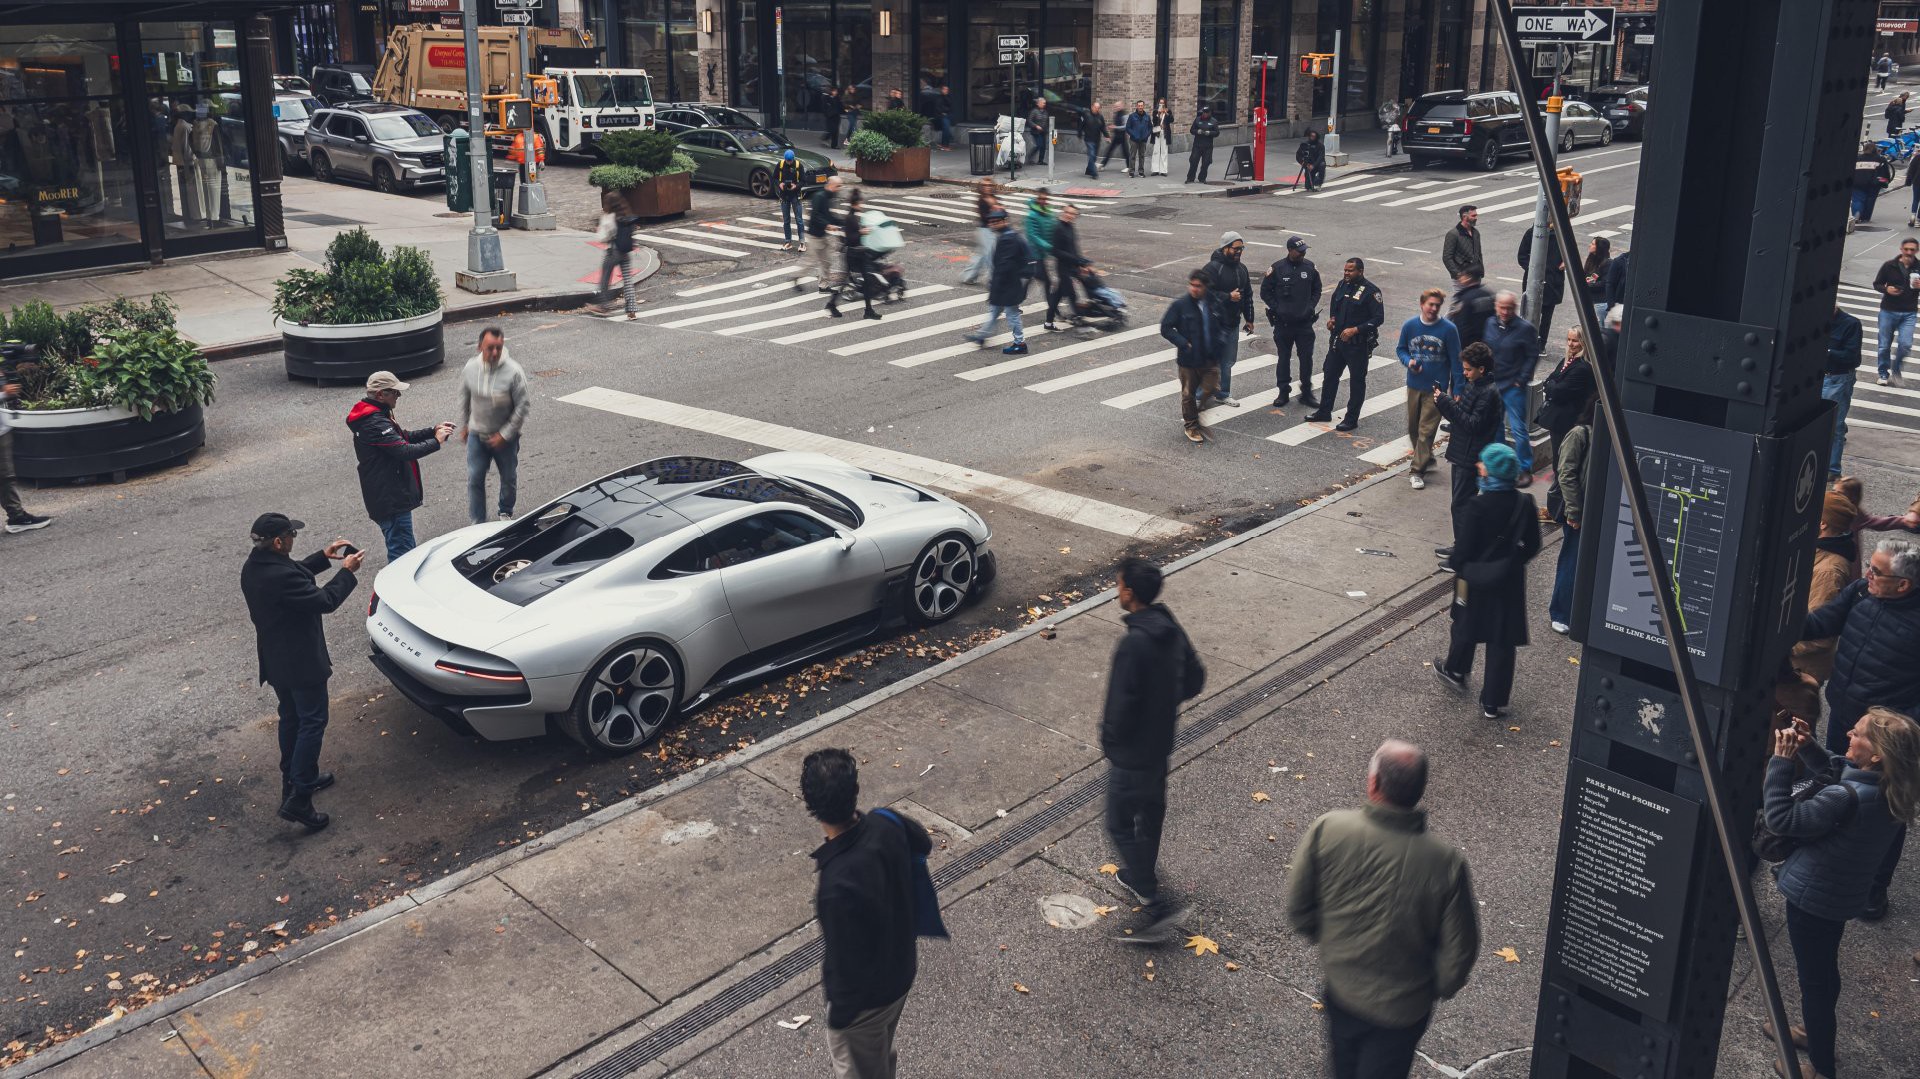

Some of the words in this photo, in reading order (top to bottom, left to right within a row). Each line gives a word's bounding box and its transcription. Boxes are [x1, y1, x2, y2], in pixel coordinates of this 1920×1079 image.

[410, 0, 448, 8] Washington
[1525, 18, 1554, 30] ONE
[1568, 18, 1598, 31] WAY
[1540, 52, 1553, 66] ONE
[378, 622, 421, 658] PORSCHE
[1604, 622, 1625, 633] HIGH
[1626, 627, 1645, 639] LINE
[1646, 634, 1668, 646] ACCE
[1687, 647, 1706, 657] INTS
[1584, 796, 1606, 808] Bicycles
[1586, 788, 1609, 802] Smoking
[1586, 777, 1606, 789] PARK
[1607, 786, 1630, 799] RULES
[1632, 795, 1670, 814] PROHIBIT
[1588, 823, 1621, 839] recreational
[1622, 837, 1645, 849] scooters
[1599, 812, 1618, 822] except
[1628, 824, 1648, 834] service
[1649, 831, 1663, 840] dogs
[1580, 827, 1602, 841] Walking
[1609, 840, 1632, 853] planting
[1632, 848, 1646, 858] beds
[1594, 841, 1618, 853] exposed
[1628, 855, 1646, 865] tracks
[1577, 850, 1594, 862] Sitting
[1604, 862, 1623, 873] railings
[1632, 873, 1656, 888] climbing
[1578, 842, 1597, 854] Picking
[1598, 850, 1617, 862] flowers
[1626, 863, 1644, 873] plants
[1573, 879, 1595, 893] Littering
[1574, 872, 1602, 887] authorized
[1603, 885, 1618, 894] areas
[1575, 864, 1597, 878] Drinking
[1620, 885, 1639, 895] except
[1625, 877, 1639, 886] High
[1639, 883, 1652, 892] Line
[1572, 887, 1596, 902] Throwing
[1597, 899, 1617, 910] objects
[1569, 910, 1598, 926] Solicitation
[1569, 903, 1601, 921] Obstructing
[1602, 918, 1628, 932] entrances
[1637, 934, 1653, 943] paths
[1570, 895, 1596, 909] Amplified
[1616, 916, 1635, 926] except
[1644, 928, 1664, 939] permit
[1566, 926, 1584, 935] permit
[1592, 938, 1619, 952] otherwise
[1620, 950, 1650, 966] authorized
[1567, 918, 1598, 935] Commercial
[1622, 944, 1640, 954] except
[1564, 940, 1592, 954] equipment
[1601, 957, 1625, 970] exclusive
[1584, 942, 1618, 960] photography
[1619, 958, 1644, 973] requiring
[1562, 953, 1578, 964] Events
[1587, 966, 1614, 980] gatherings
[1615, 979, 1635, 989] greater
[1636, 988, 1649, 996] than
[1592, 959, 1609, 969] except
[1618, 972, 1637, 983] permit
[1592, 974, 1609, 985] except
[1618, 987, 1637, 998] permit
